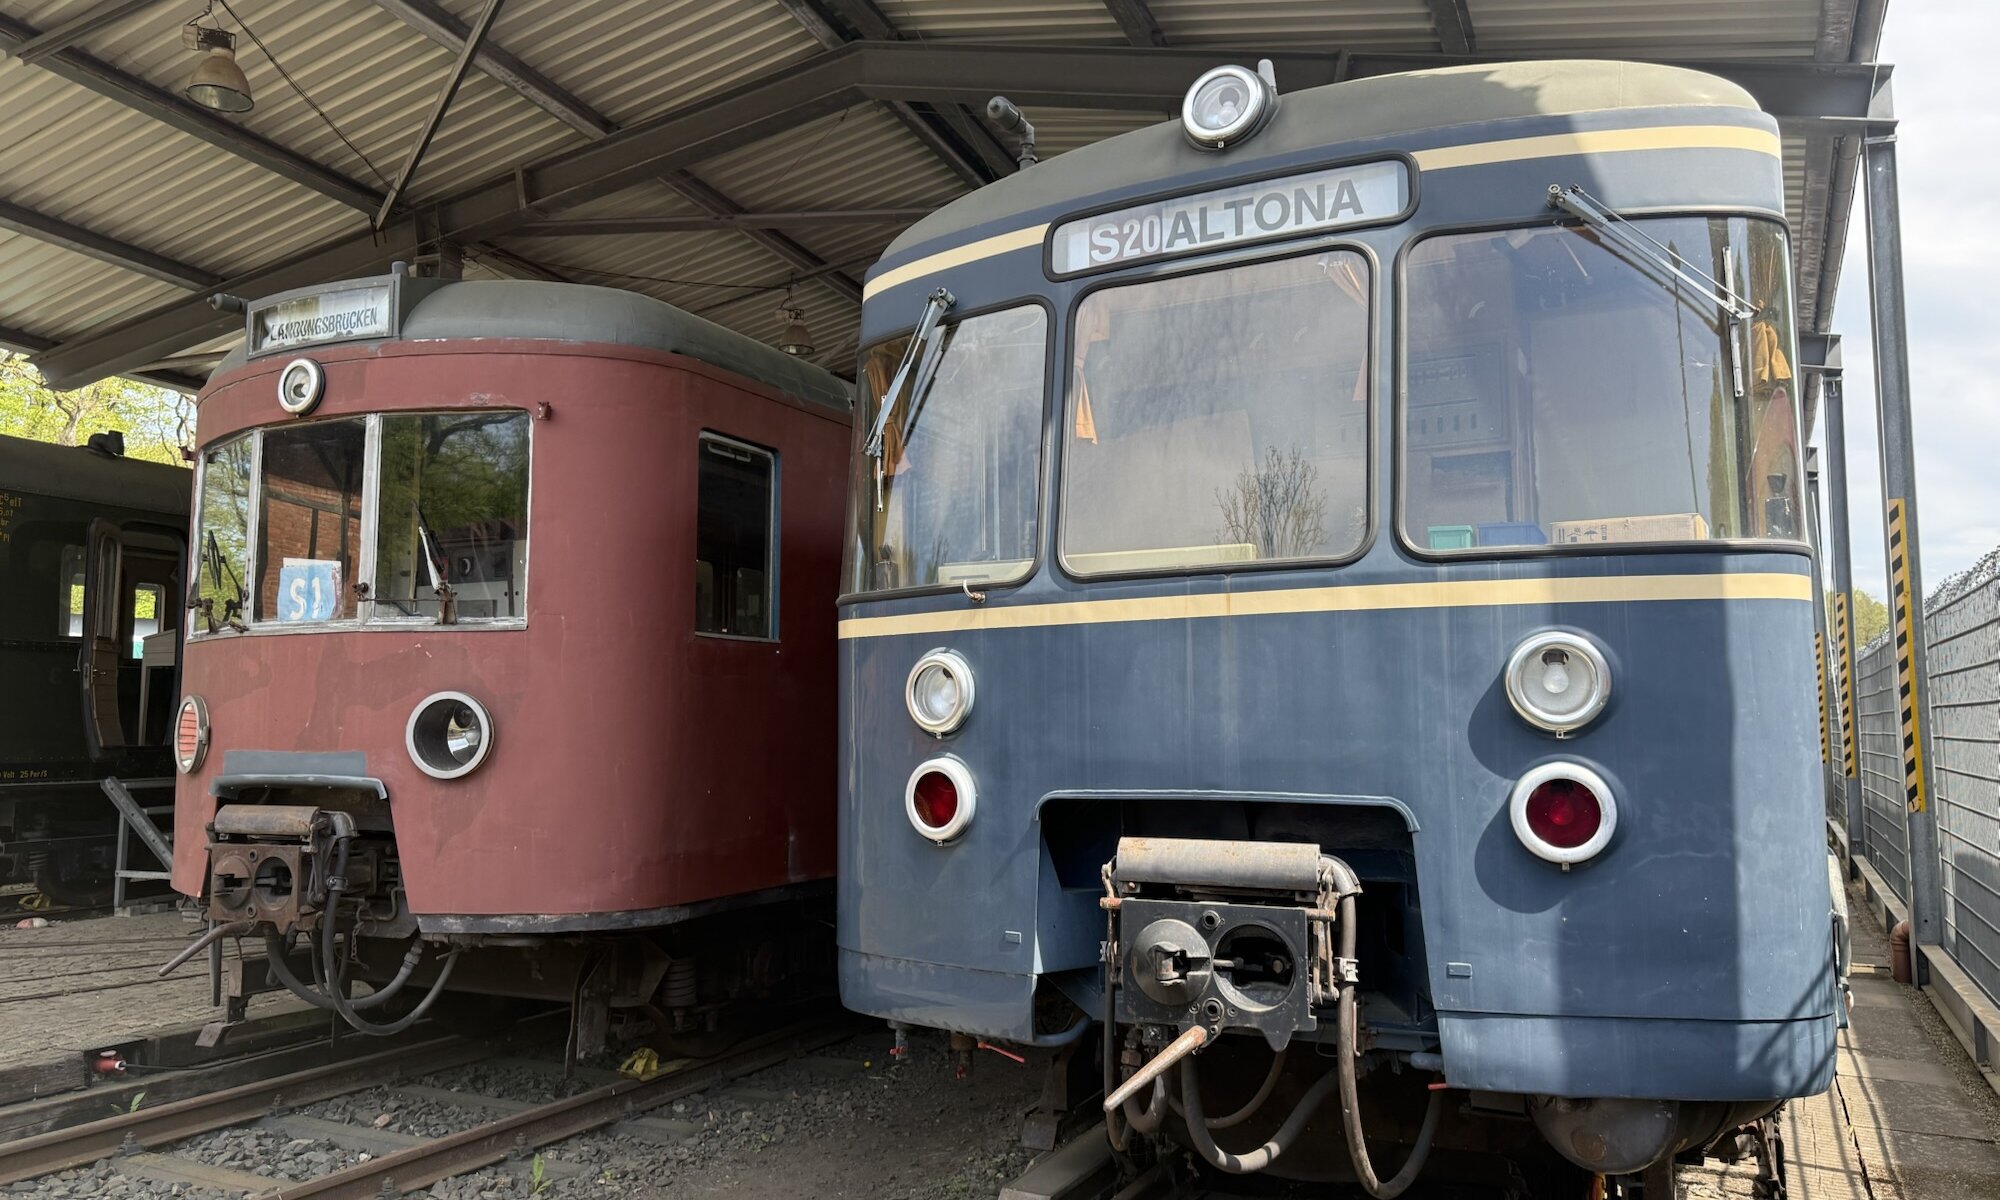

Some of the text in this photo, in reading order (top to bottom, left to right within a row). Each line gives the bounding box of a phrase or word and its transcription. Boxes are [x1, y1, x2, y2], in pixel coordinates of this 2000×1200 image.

[1090, 178, 1364, 263] S20 ALTONA
[270, 306, 378, 342] LANDUNGSBRÜCKEN
[289, 576, 321, 620] S1
